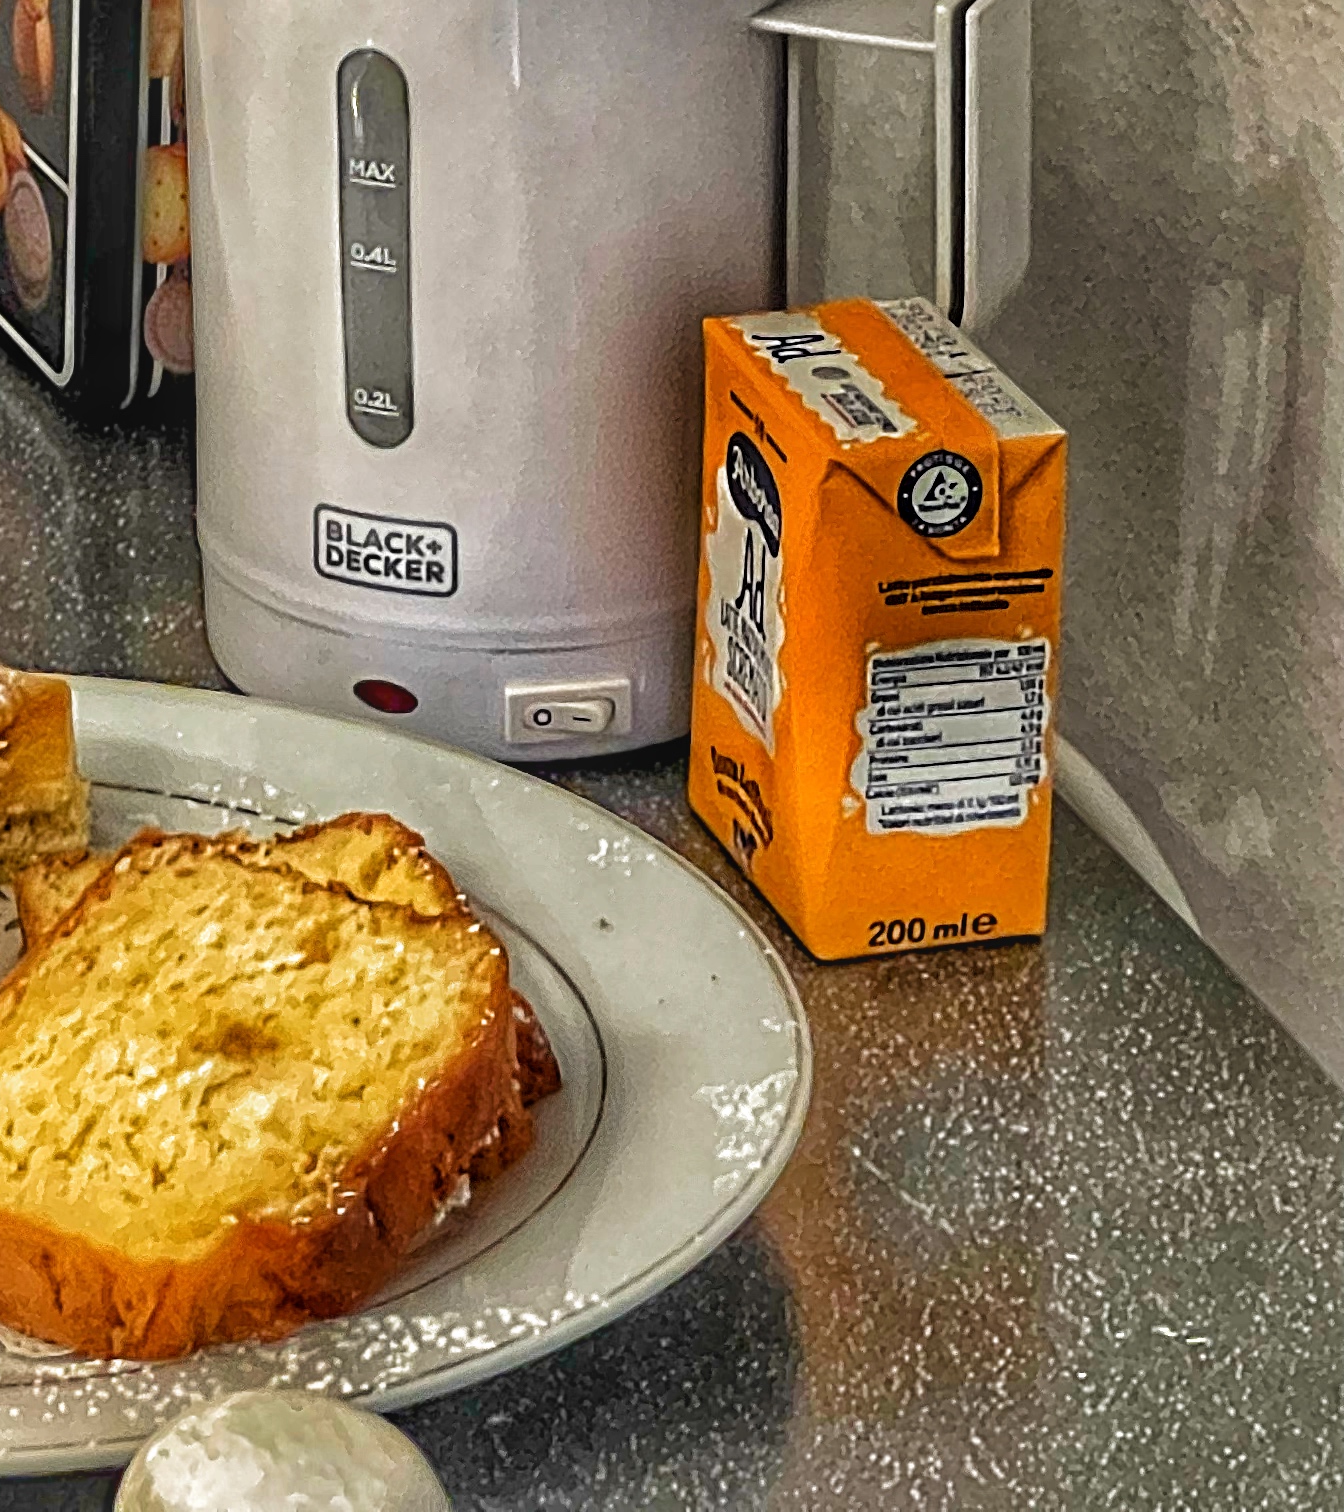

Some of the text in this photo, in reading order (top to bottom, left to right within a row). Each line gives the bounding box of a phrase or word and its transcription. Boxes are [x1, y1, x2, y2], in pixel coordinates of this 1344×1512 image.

[349, 158, 395, 181] MAX
[351, 243, 396, 265] 0.4L
[751, 334, 841, 363] Ad
[354, 389, 397, 410] 0.2L
[326, 520, 442, 557] BLACK+
[326, 545, 445, 583] DECKER
[735, 527, 766, 642] Ad
[869, 917, 925, 947] 200
[933, 913, 968, 939] ml
